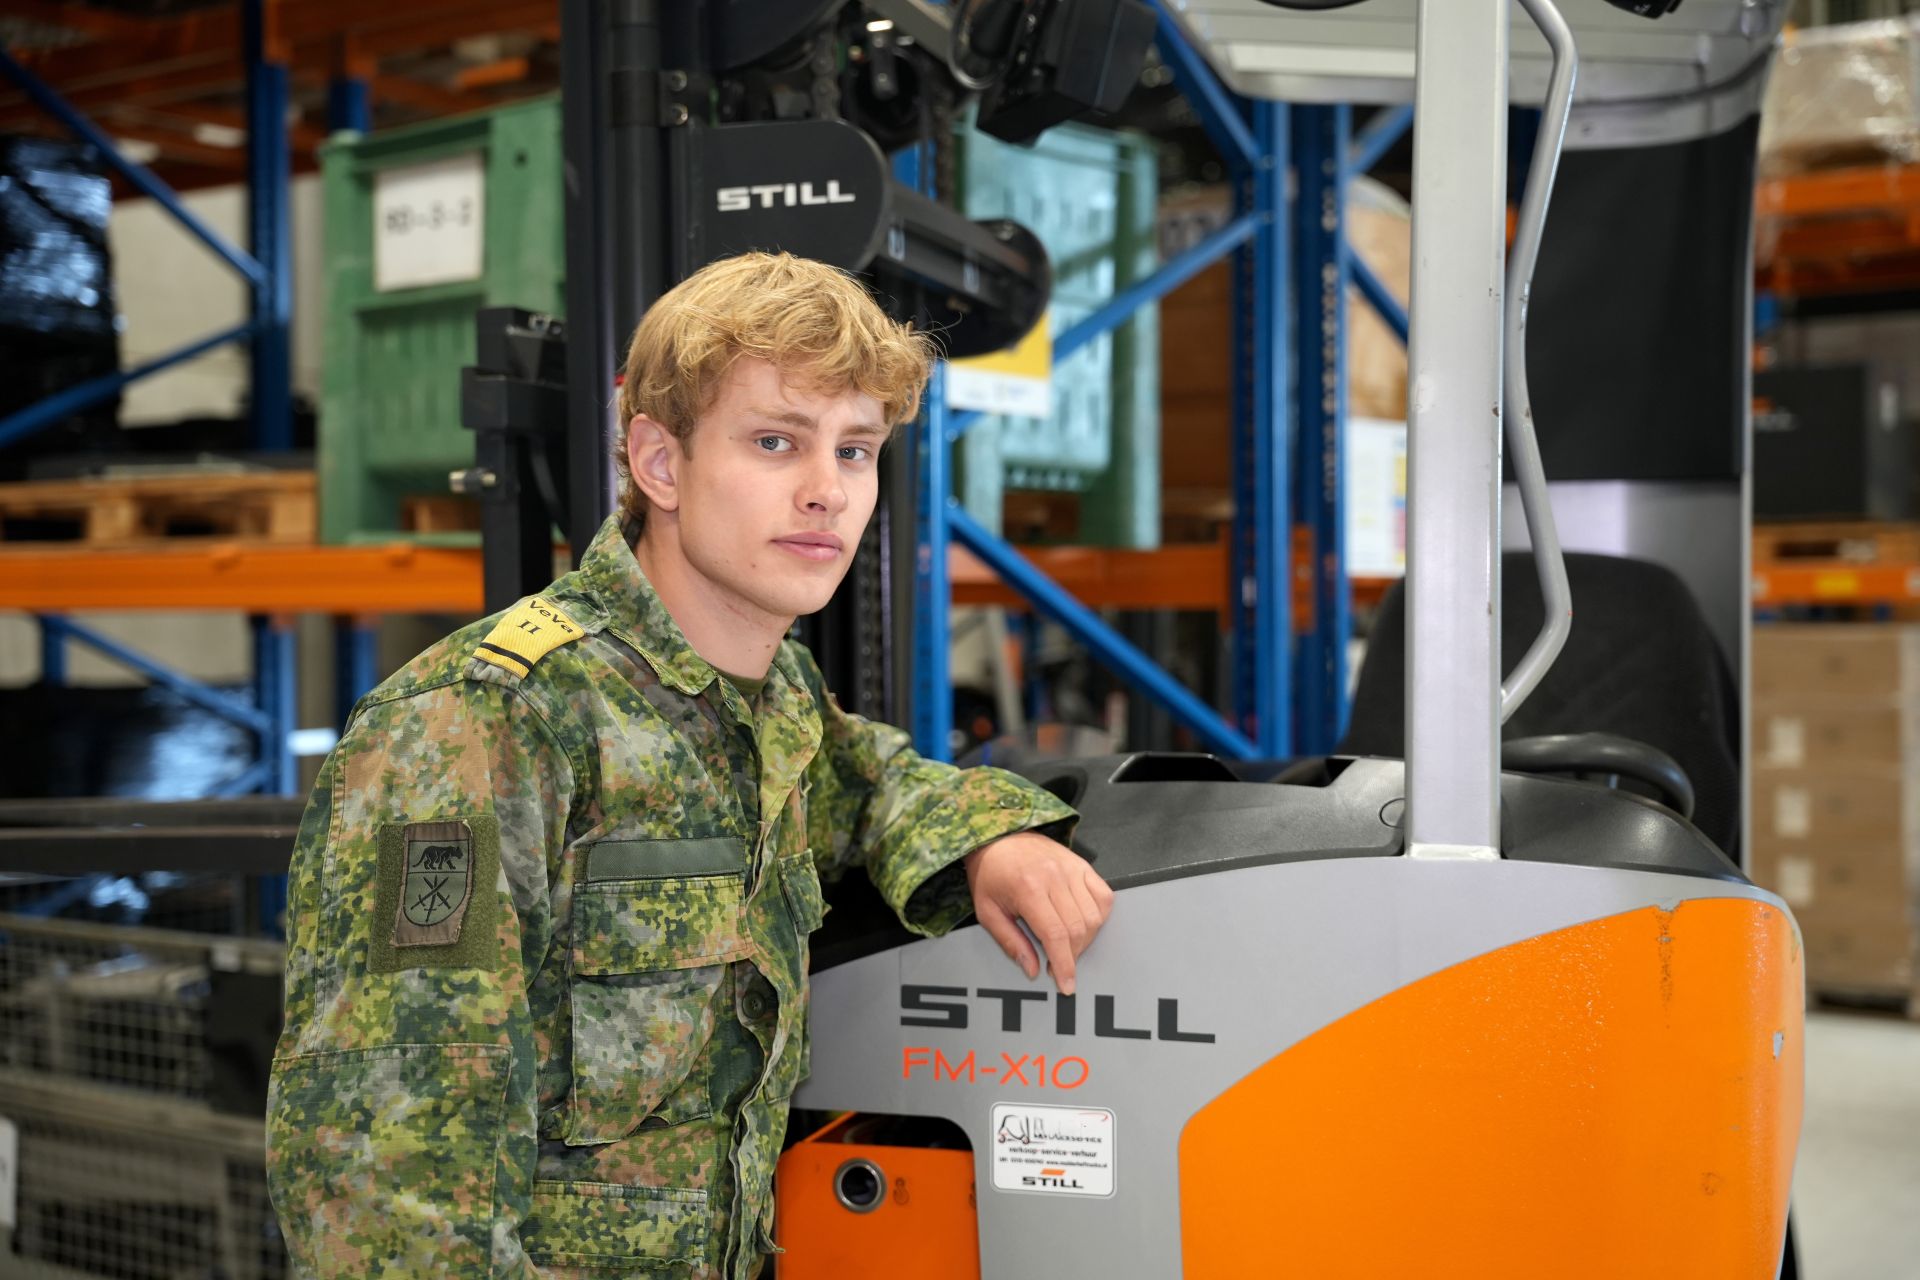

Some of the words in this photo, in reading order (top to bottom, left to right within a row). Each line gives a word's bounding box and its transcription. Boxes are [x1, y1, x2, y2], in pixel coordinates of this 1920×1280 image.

[717, 180, 856, 212] STILL
[529, 600, 574, 633] VeVa
[900, 984, 1216, 1044] STILL
[902, 1047, 1090, 1090] FM-X10
[1022, 1175, 1084, 1189] STILL
